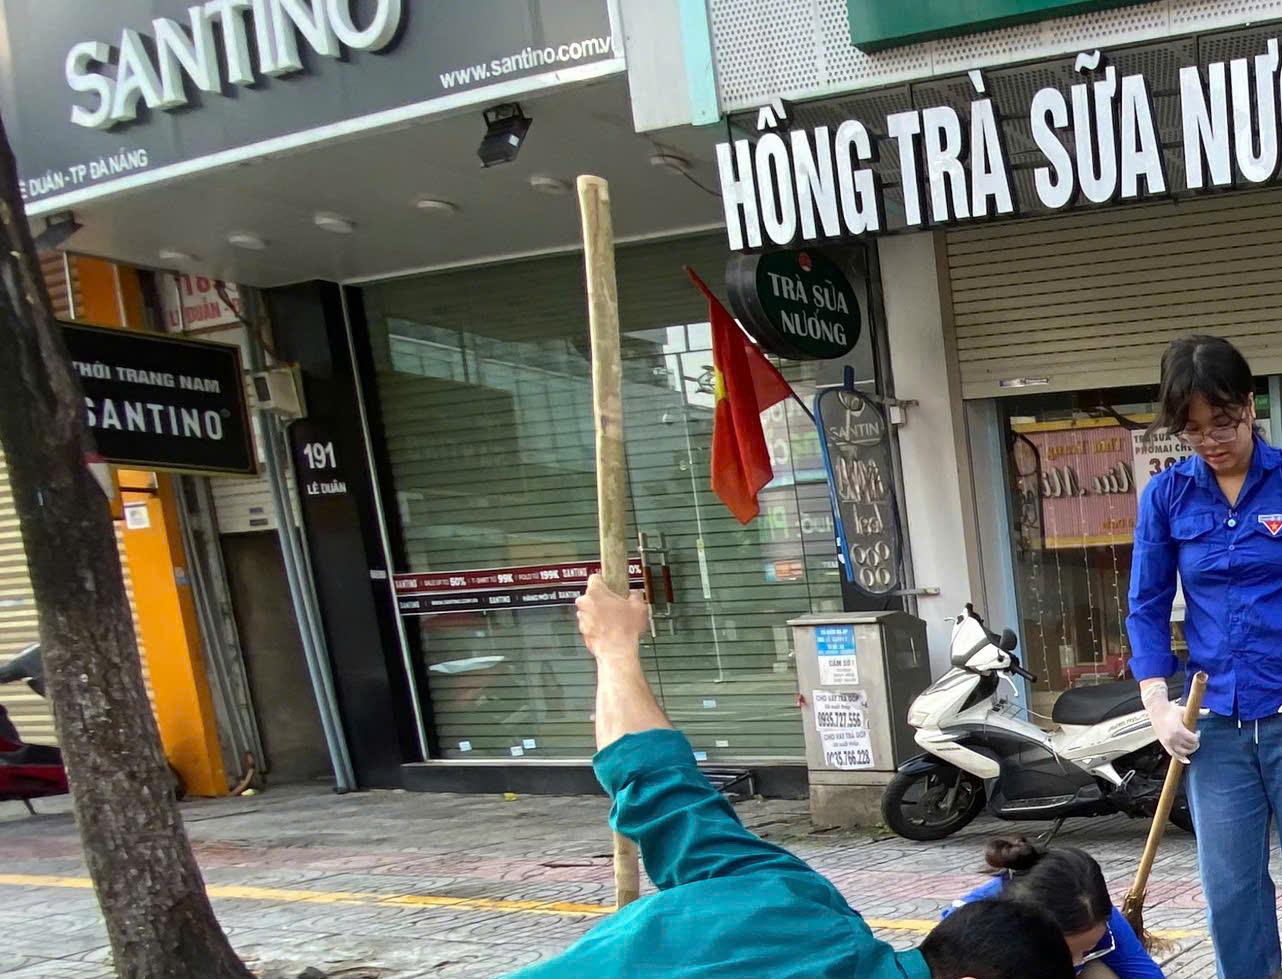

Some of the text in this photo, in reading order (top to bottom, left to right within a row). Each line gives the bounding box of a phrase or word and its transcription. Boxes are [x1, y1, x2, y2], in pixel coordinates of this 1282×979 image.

[65, 0, 402, 129] SANTINO
[716, 98, 879, 250] HỒNG
[887, 70, 1013, 225] TRÀ
[1031, 50, 1166, 209] SỮA
[767, 271, 808, 304] TRÀ
[780, 307, 847, 345] NƯỚNG
[115, 366, 174, 388] TRANG
[179, 375, 221, 394] NAM
[303, 441, 336, 469] 191
[306, 480, 320, 494] LÊ
[450, 576, 466, 586] 50%
